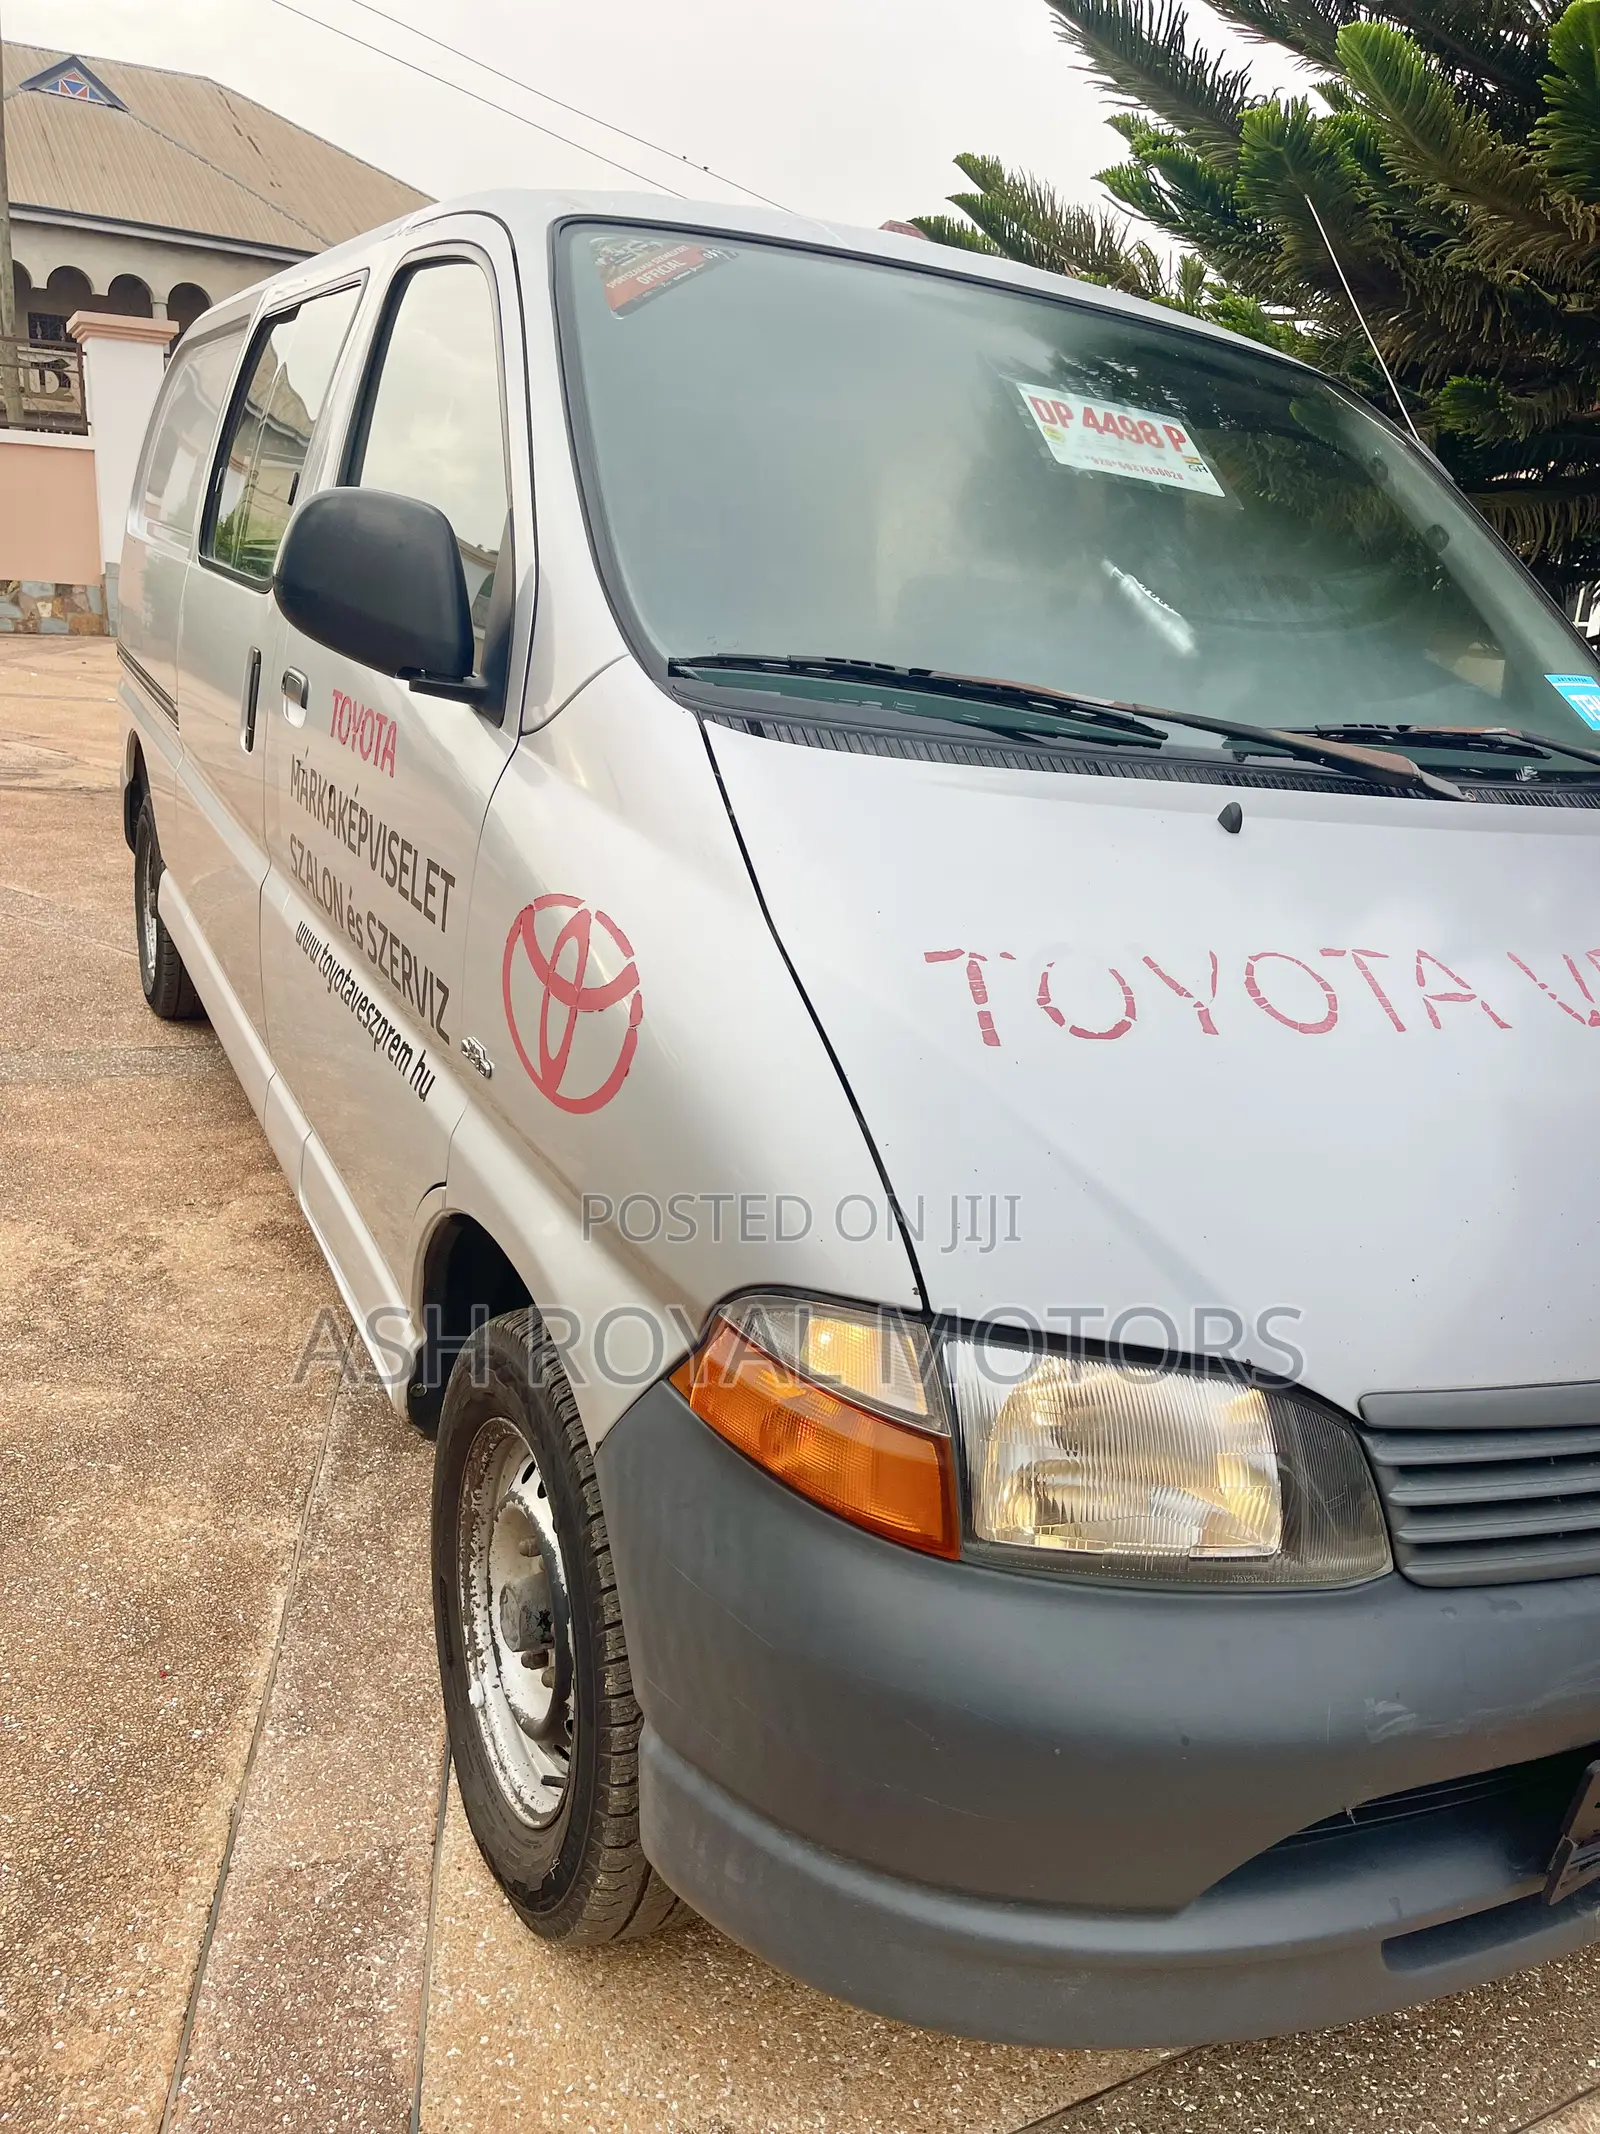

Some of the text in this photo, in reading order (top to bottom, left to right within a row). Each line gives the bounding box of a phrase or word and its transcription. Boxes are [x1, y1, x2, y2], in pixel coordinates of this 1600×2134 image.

[636, 259, 687, 285] OFFICIAL
[1028, 395, 1187, 453] DP 4498 P
[1188, 464, 1209, 474] GH
[329, 688, 397, 778] TOYOTA
[290, 745, 456, 933] MÁRKAKÉPVISELET
[290, 832, 450, 1046] SZALON és SZERVIZ
[924, 948, 1600, 1047] TOYOTA V
